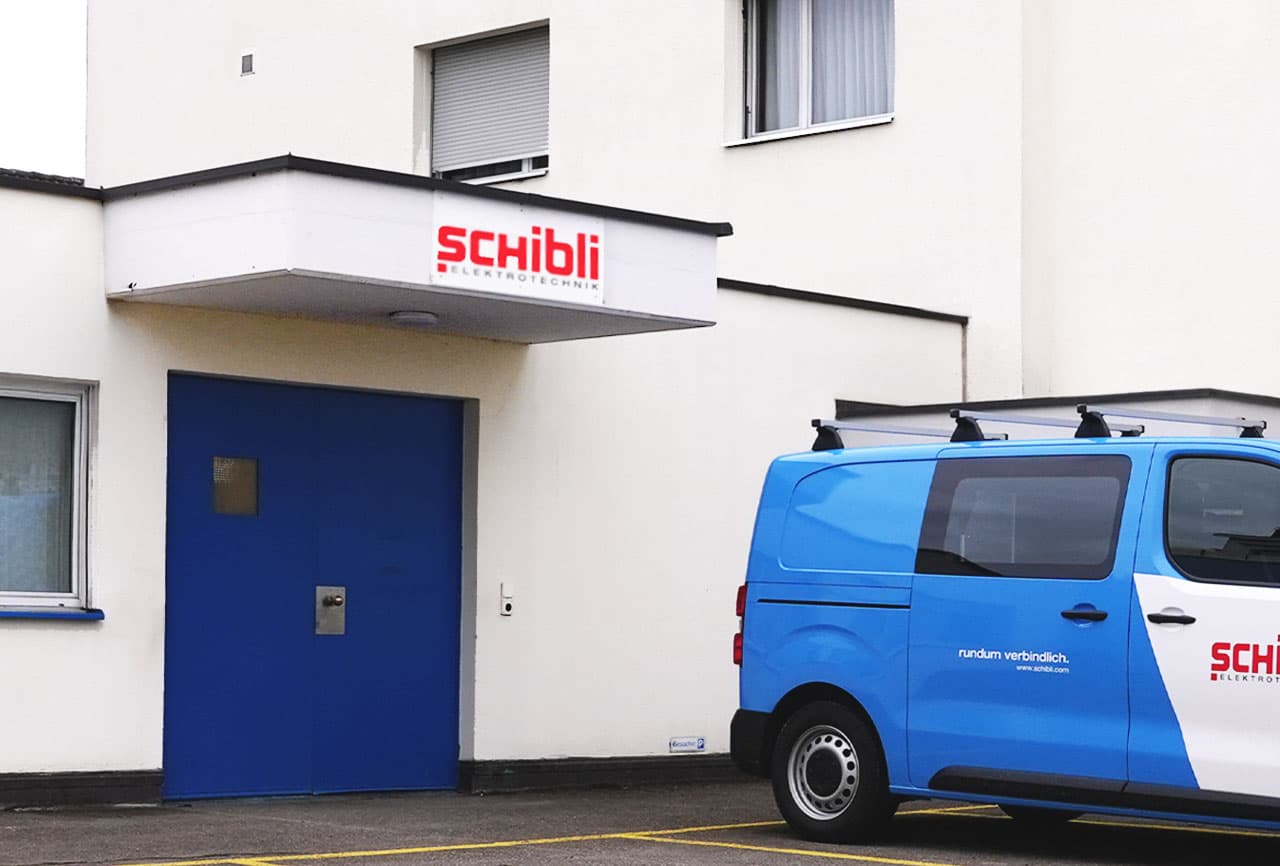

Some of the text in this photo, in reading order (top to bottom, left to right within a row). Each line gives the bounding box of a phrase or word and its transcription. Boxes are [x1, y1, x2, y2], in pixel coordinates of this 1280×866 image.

[451, 265, 600, 290] ELEKTROTECHNIK
[958, 648, 1070, 664] rundum verbindlich.
[1016, 665, 1070, 674] www.schibli.com
